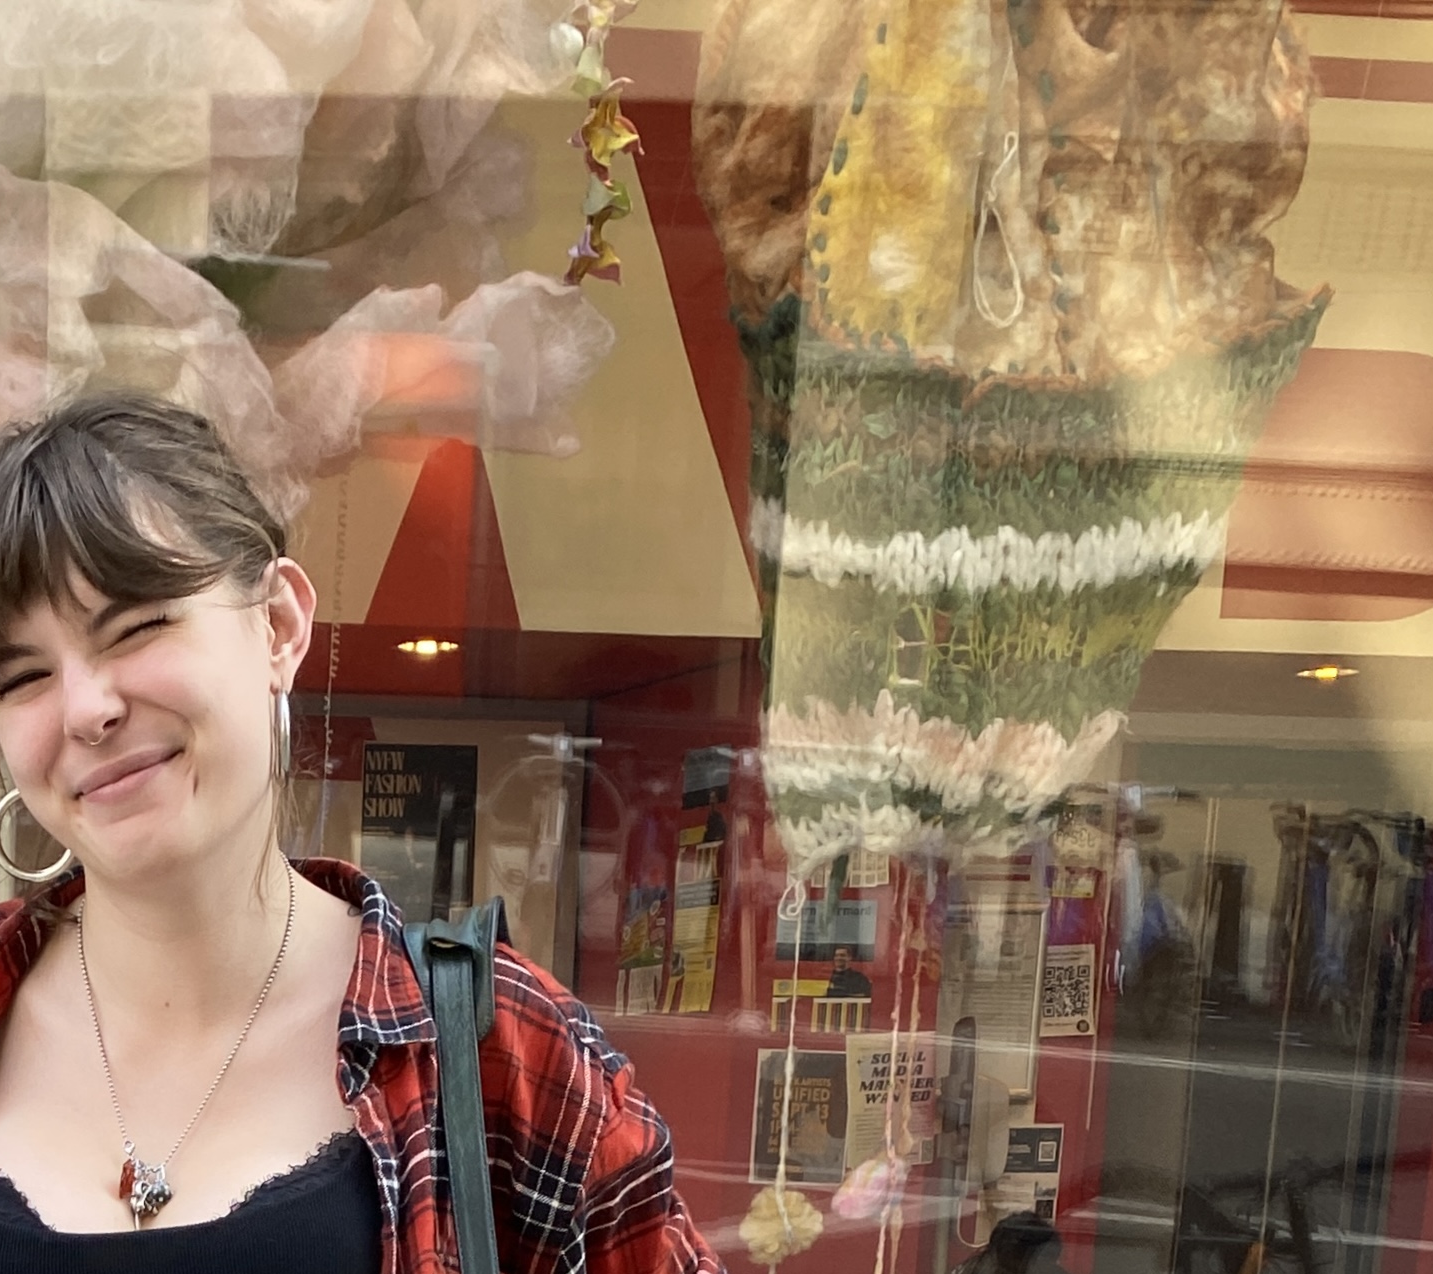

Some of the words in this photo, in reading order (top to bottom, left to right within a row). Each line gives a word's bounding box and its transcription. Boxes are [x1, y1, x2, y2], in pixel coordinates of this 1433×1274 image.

[367, 751, 405, 771] NYFW
[366, 773, 422, 794] FASHION
[364, 797, 405, 818] SHOW
[872, 1064, 924, 1078] MDA
[859, 1077, 934, 1092] MANER
[773, 1086, 831, 1102] UIFIED
[865, 1090, 931, 1104] WANED
[771, 1101, 810, 1119] SPT
